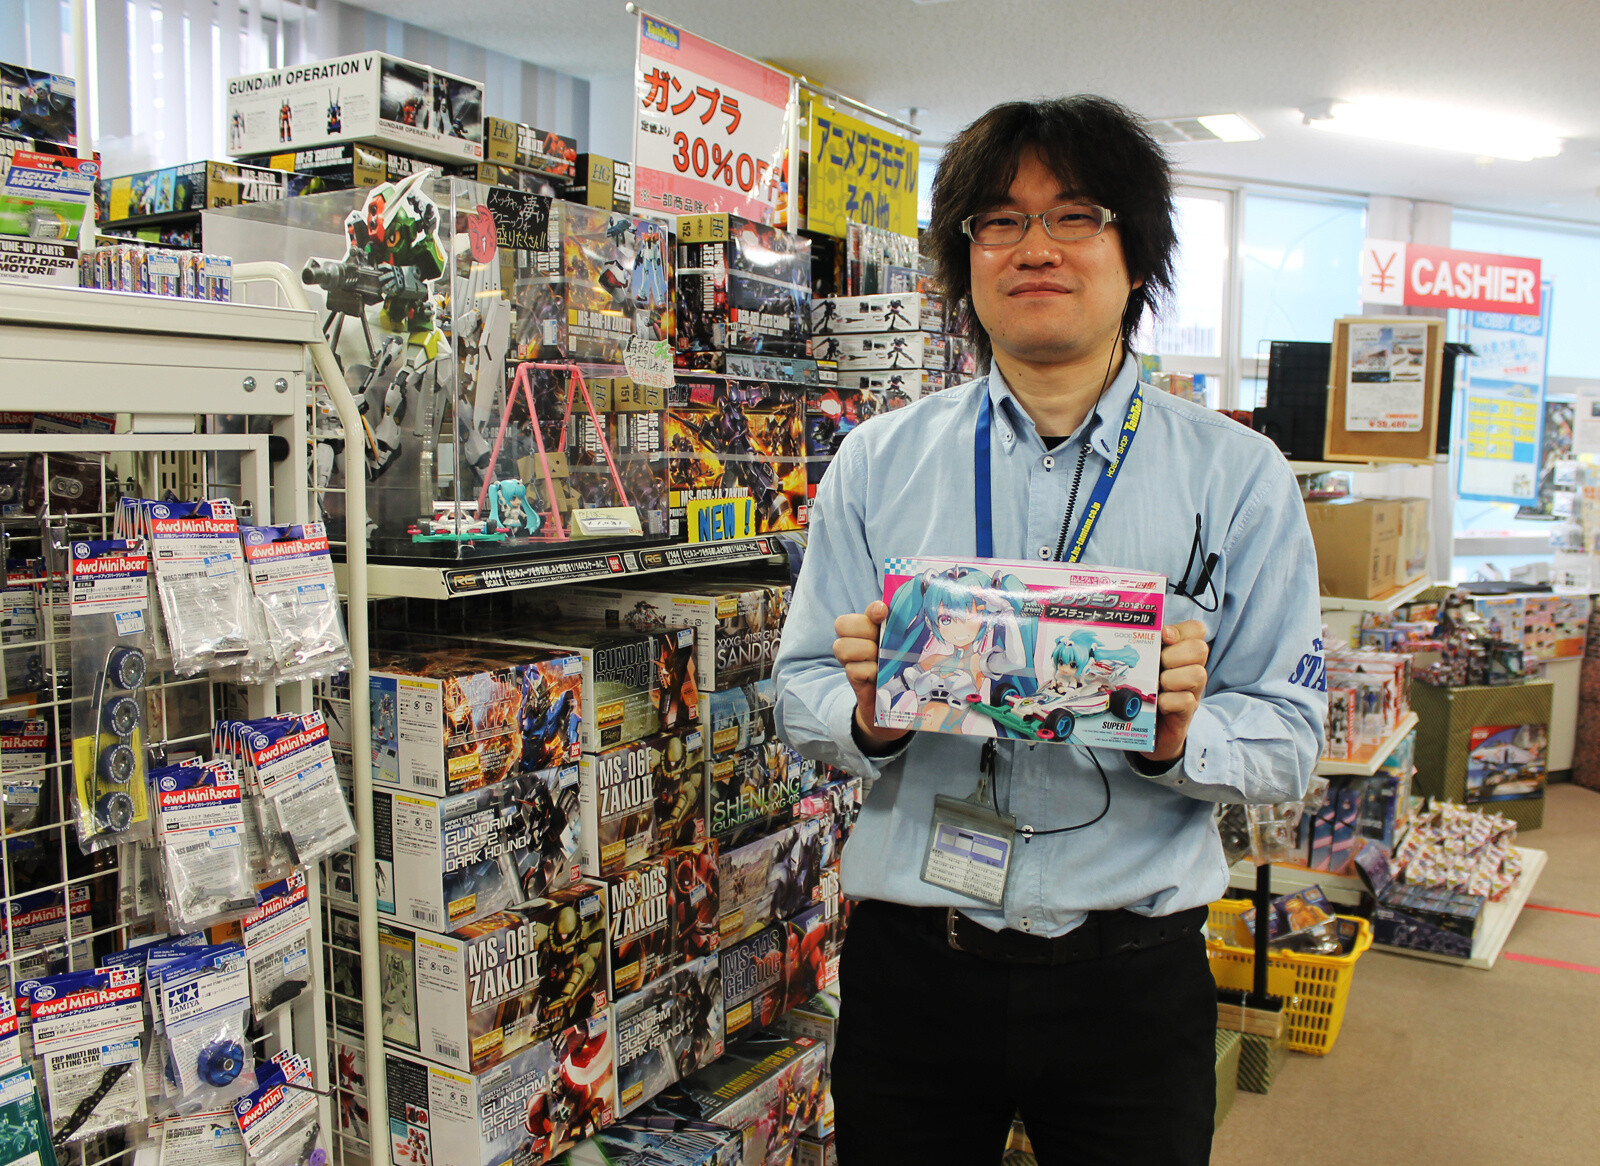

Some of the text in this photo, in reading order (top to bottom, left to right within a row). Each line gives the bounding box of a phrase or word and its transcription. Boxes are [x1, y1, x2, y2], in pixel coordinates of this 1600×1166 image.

[229, 57, 373, 95] GUNDAM OPERATION V
[641, 67, 742, 135] ガンプラ
[379, 120, 404, 132] GUNDAM
[405, 126, 436, 139] OPERATION
[493, 120, 514, 140] HG
[817, 119, 917, 194] アニメプラモデル
[591, 164, 611, 182] HG
[682, 221, 691, 237] 152
[37, 243, 65, 257] PARTS
[1411, 257, 1535, 304] CASHIER
[620, 385, 630, 403] 151
[636, 413, 649, 441] ZAKU
[1117, 434, 1129, 455] SHOP
[156, 520, 181, 532] 4wd
[205, 521, 235, 532] Racer
[698, 500, 752, 543] NEW !
[251, 545, 275, 557] 4wd
[297, 541, 326, 553] Racer
[668, 558, 683, 566] SCALE
[75, 559, 98, 574] 4wd
[120, 559, 146, 571] Racer
[481, 570, 501, 581] 1/144
[484, 579, 505, 588] SCALE
[1104, 611, 1150, 623] スペシャル
[1119, 601, 1158, 611] 2012ver.
[1132, 632, 1155, 641] SMILE
[595, 639, 660, 674] GUNDAM
[1102, 721, 1126, 731] SUPER
[258, 747, 280, 762] 4wd
[299, 728, 325, 746] Racer
[599, 746, 652, 788] MS-06F
[163, 791, 187, 805] 4wd
[209, 788, 237, 800] Racer
[600, 779, 641, 817] ZAKU
[712, 775, 800, 823] SHENLONG
[445, 814, 513, 846] GUNDAM
[712, 807, 765, 833] GUNDAM
[446, 832, 499, 860] AGE-2
[446, 835, 528, 873] DARK HOUND
[611, 866, 668, 913] MS-06S
[613, 901, 656, 941] ZAKU
[467, 920, 537, 977] MS-06F
[469, 956, 524, 1007] ZAKU
[36, 986, 137, 1016] 4wd Mini Racer
[169, 1000, 200, 1015] TAMIYA
[619, 1007, 672, 1043] GUNDAM
[51, 1054, 65, 1065] FRP
[65, 1050, 86, 1062] MULTI
[52, 1054, 100, 1071] SETTING STAY
[619, 1042, 648, 1066] DARK
[264, 1089, 283, 1112] Mini
[481, 1075, 547, 1119] GUNDAM
[482, 1098, 527, 1132] AGE-1
[482, 1109, 530, 1143] TITUS
